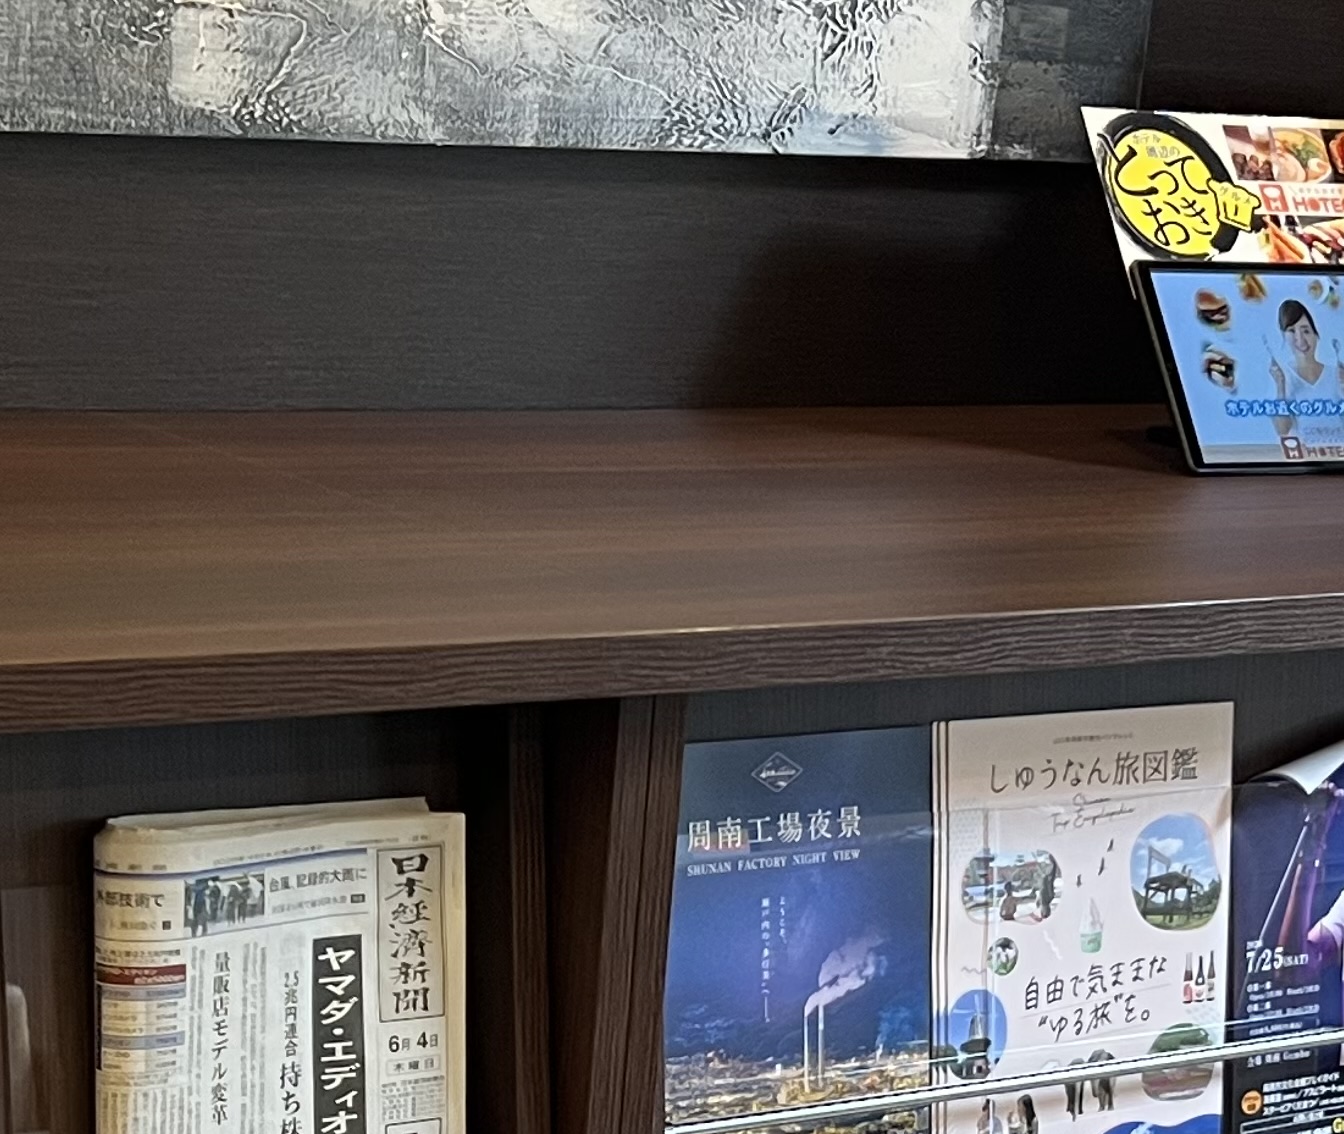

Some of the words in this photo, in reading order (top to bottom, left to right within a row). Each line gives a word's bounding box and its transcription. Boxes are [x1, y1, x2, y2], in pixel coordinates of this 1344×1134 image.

[990, 746, 1198, 794] しゅうなん旅図鑑
[687, 805, 862, 853] 周南工場夜景
[687, 861, 732, 877] SHUNAN
[738, 856, 788, 872] FACTORY
[793, 851, 826, 867] NIGHT
[833, 848, 861, 862] VIEW
[1024, 955, 1168, 1011] 自由で気ままな
[389, 1032, 439, 1052] 6月4日
[393, 1058, 435, 1073] 木曜日
